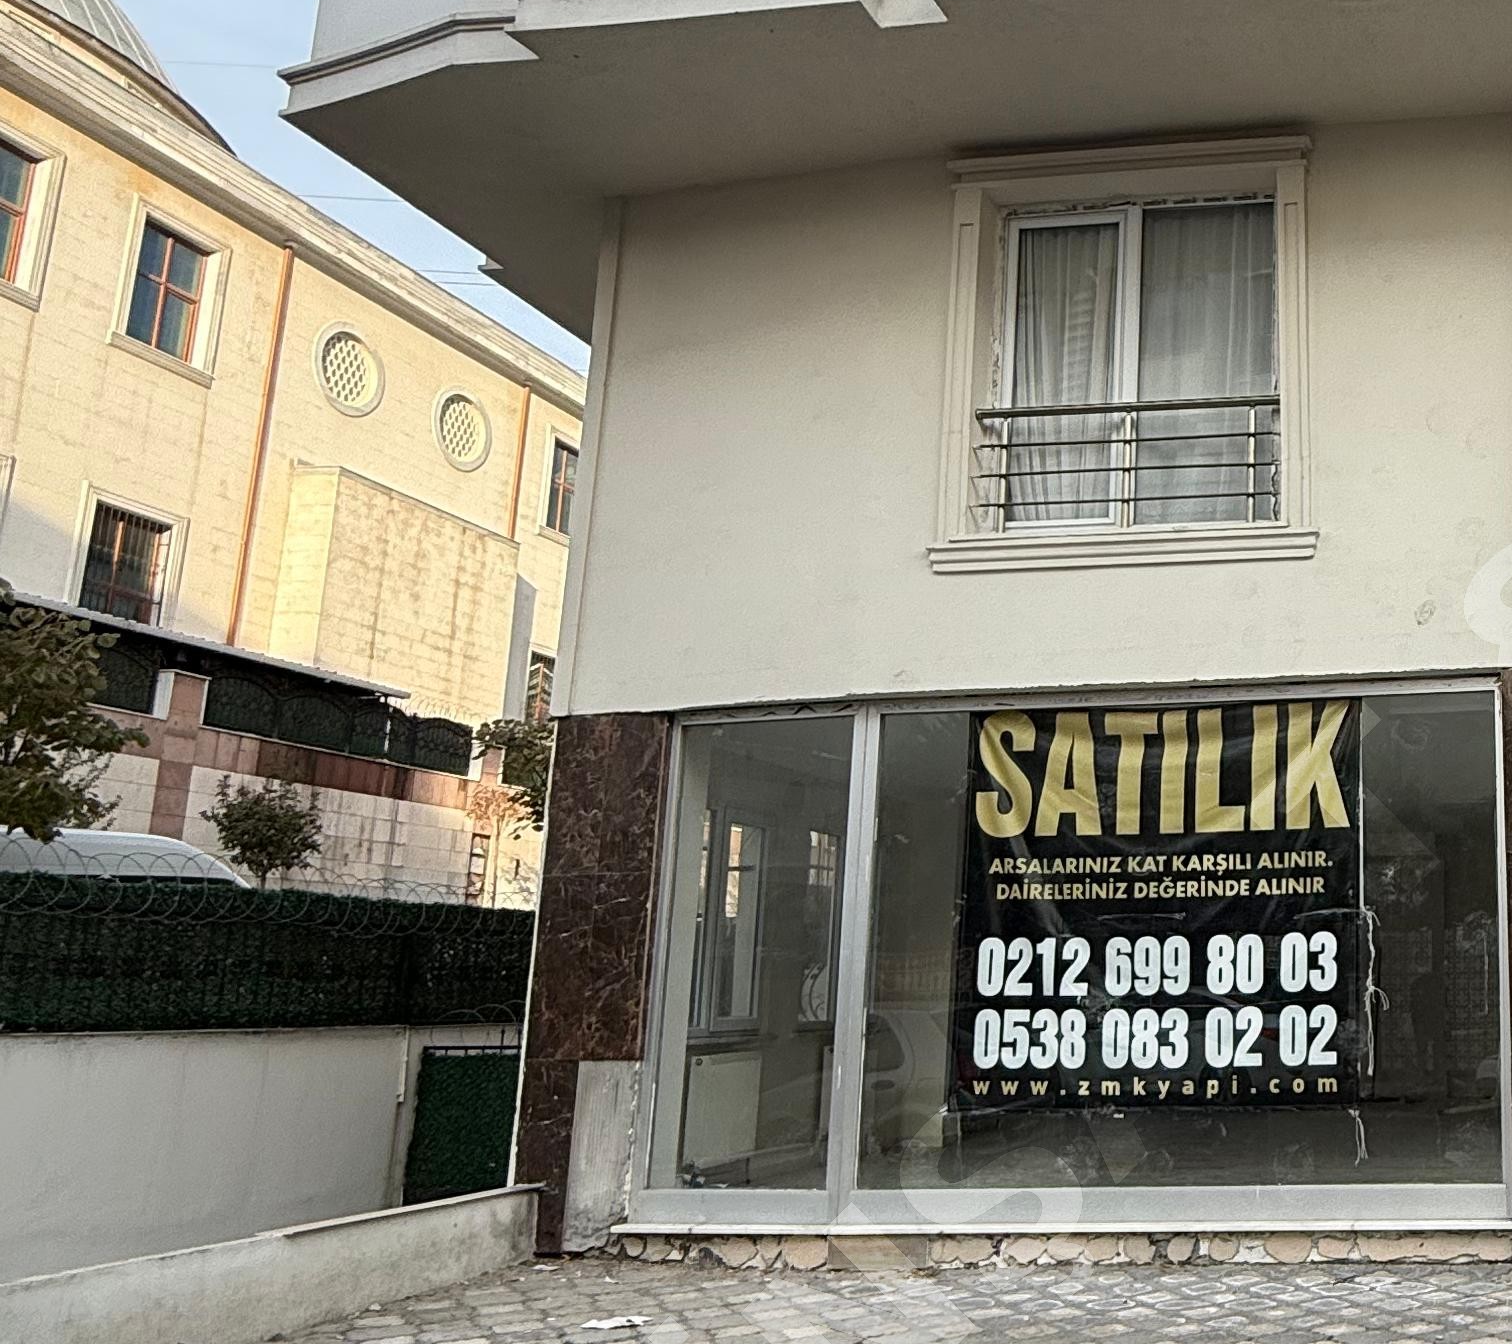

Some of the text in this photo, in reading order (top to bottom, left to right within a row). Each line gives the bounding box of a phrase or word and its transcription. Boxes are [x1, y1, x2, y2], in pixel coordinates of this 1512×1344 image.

[975, 700, 1351, 837] SATILIK
[988, 851, 1334, 875] ARSALARINIZ KAT KARŞILI ALINIR.
[996, 876, 1325, 900] DAİRELERİNİZ DEĞERİNDE ALINIR
[976, 931, 1337, 997] 0212 699 80 03
[973, 1004, 1337, 1069] 0538 083 02 02
[972, 1075, 1338, 1099] www.zmkyapi.com
